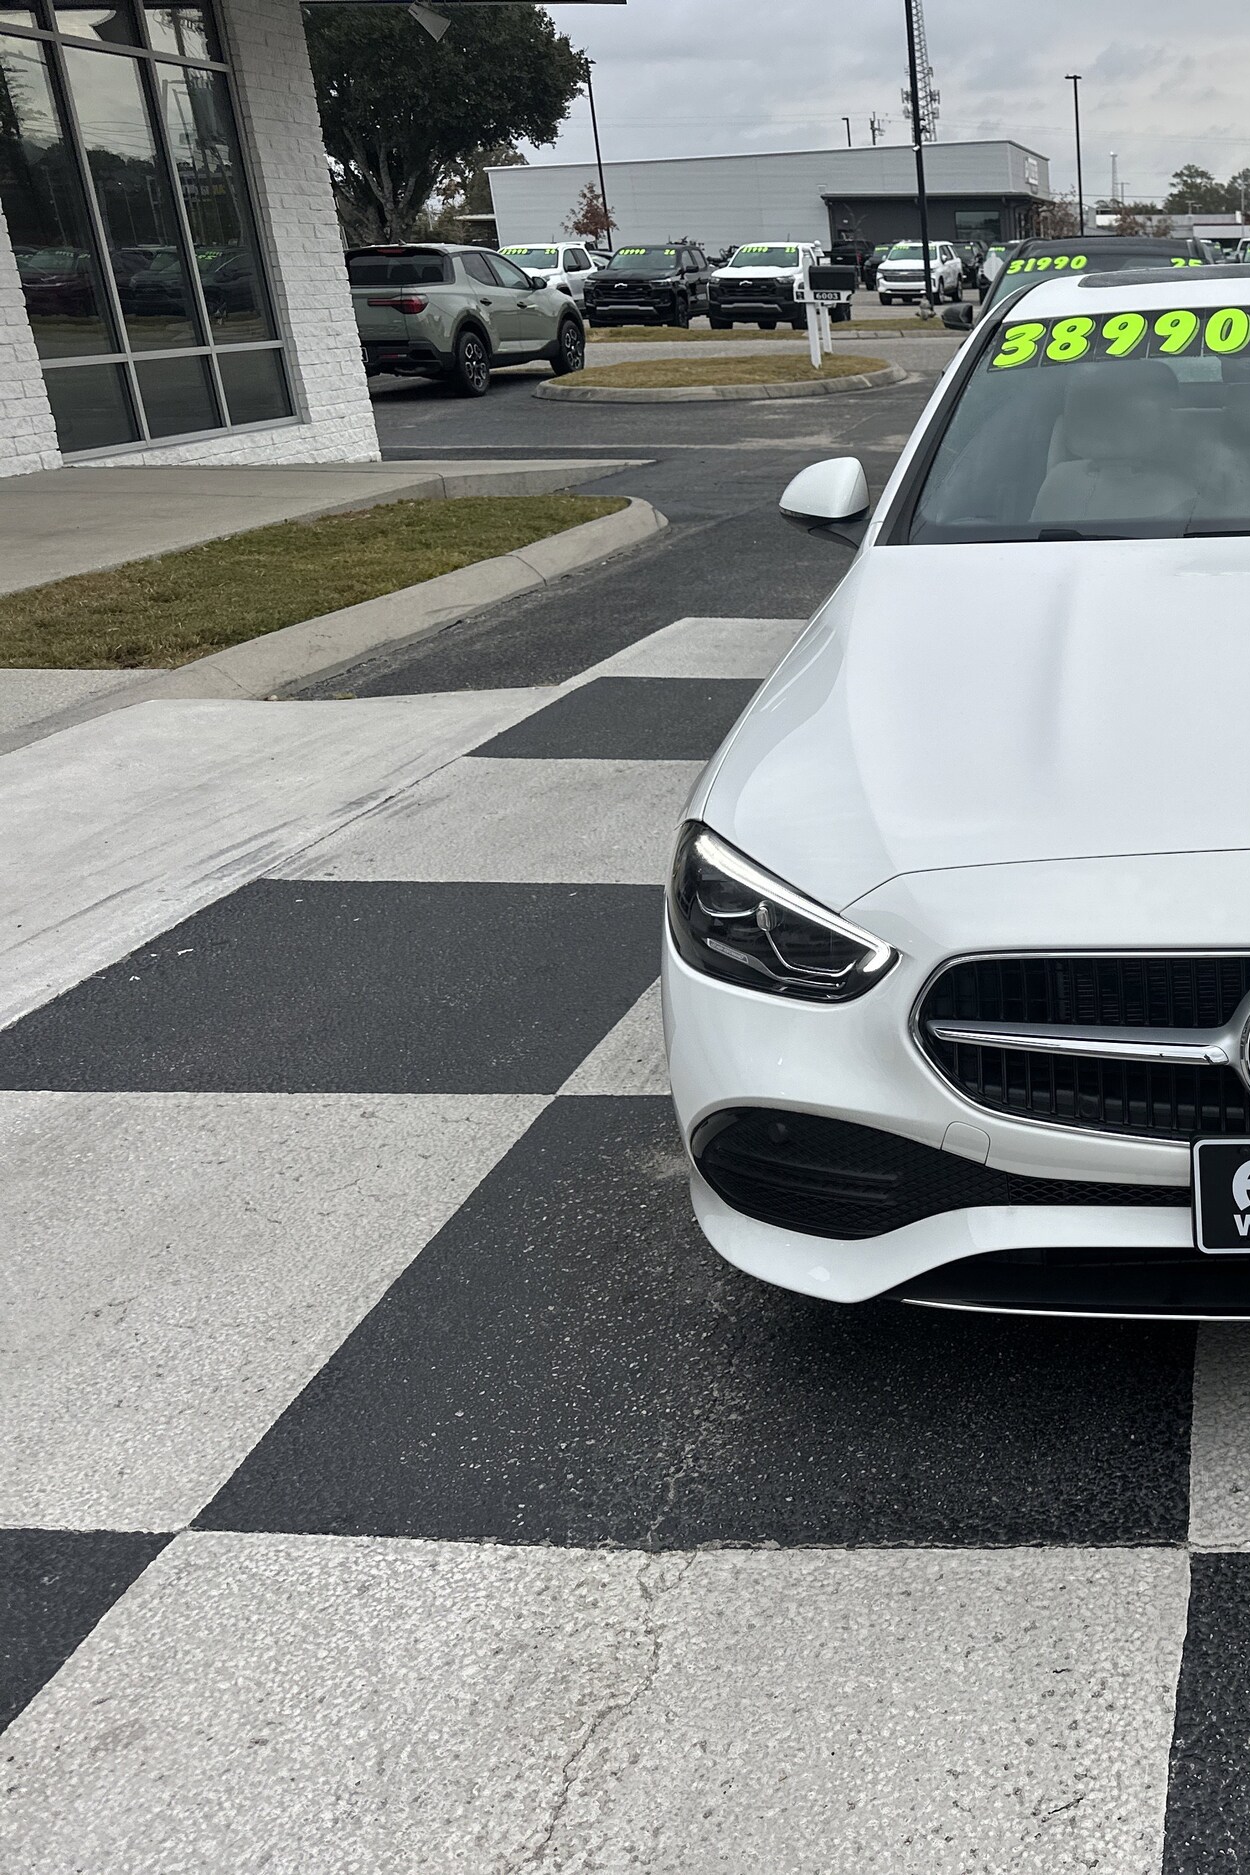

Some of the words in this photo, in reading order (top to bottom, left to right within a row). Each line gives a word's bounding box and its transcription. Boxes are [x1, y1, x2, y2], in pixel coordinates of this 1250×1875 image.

[1006, 255, 1088, 275] 31990
[1171, 258, 1202, 268] 25
[816, 292, 839, 300] 6003
